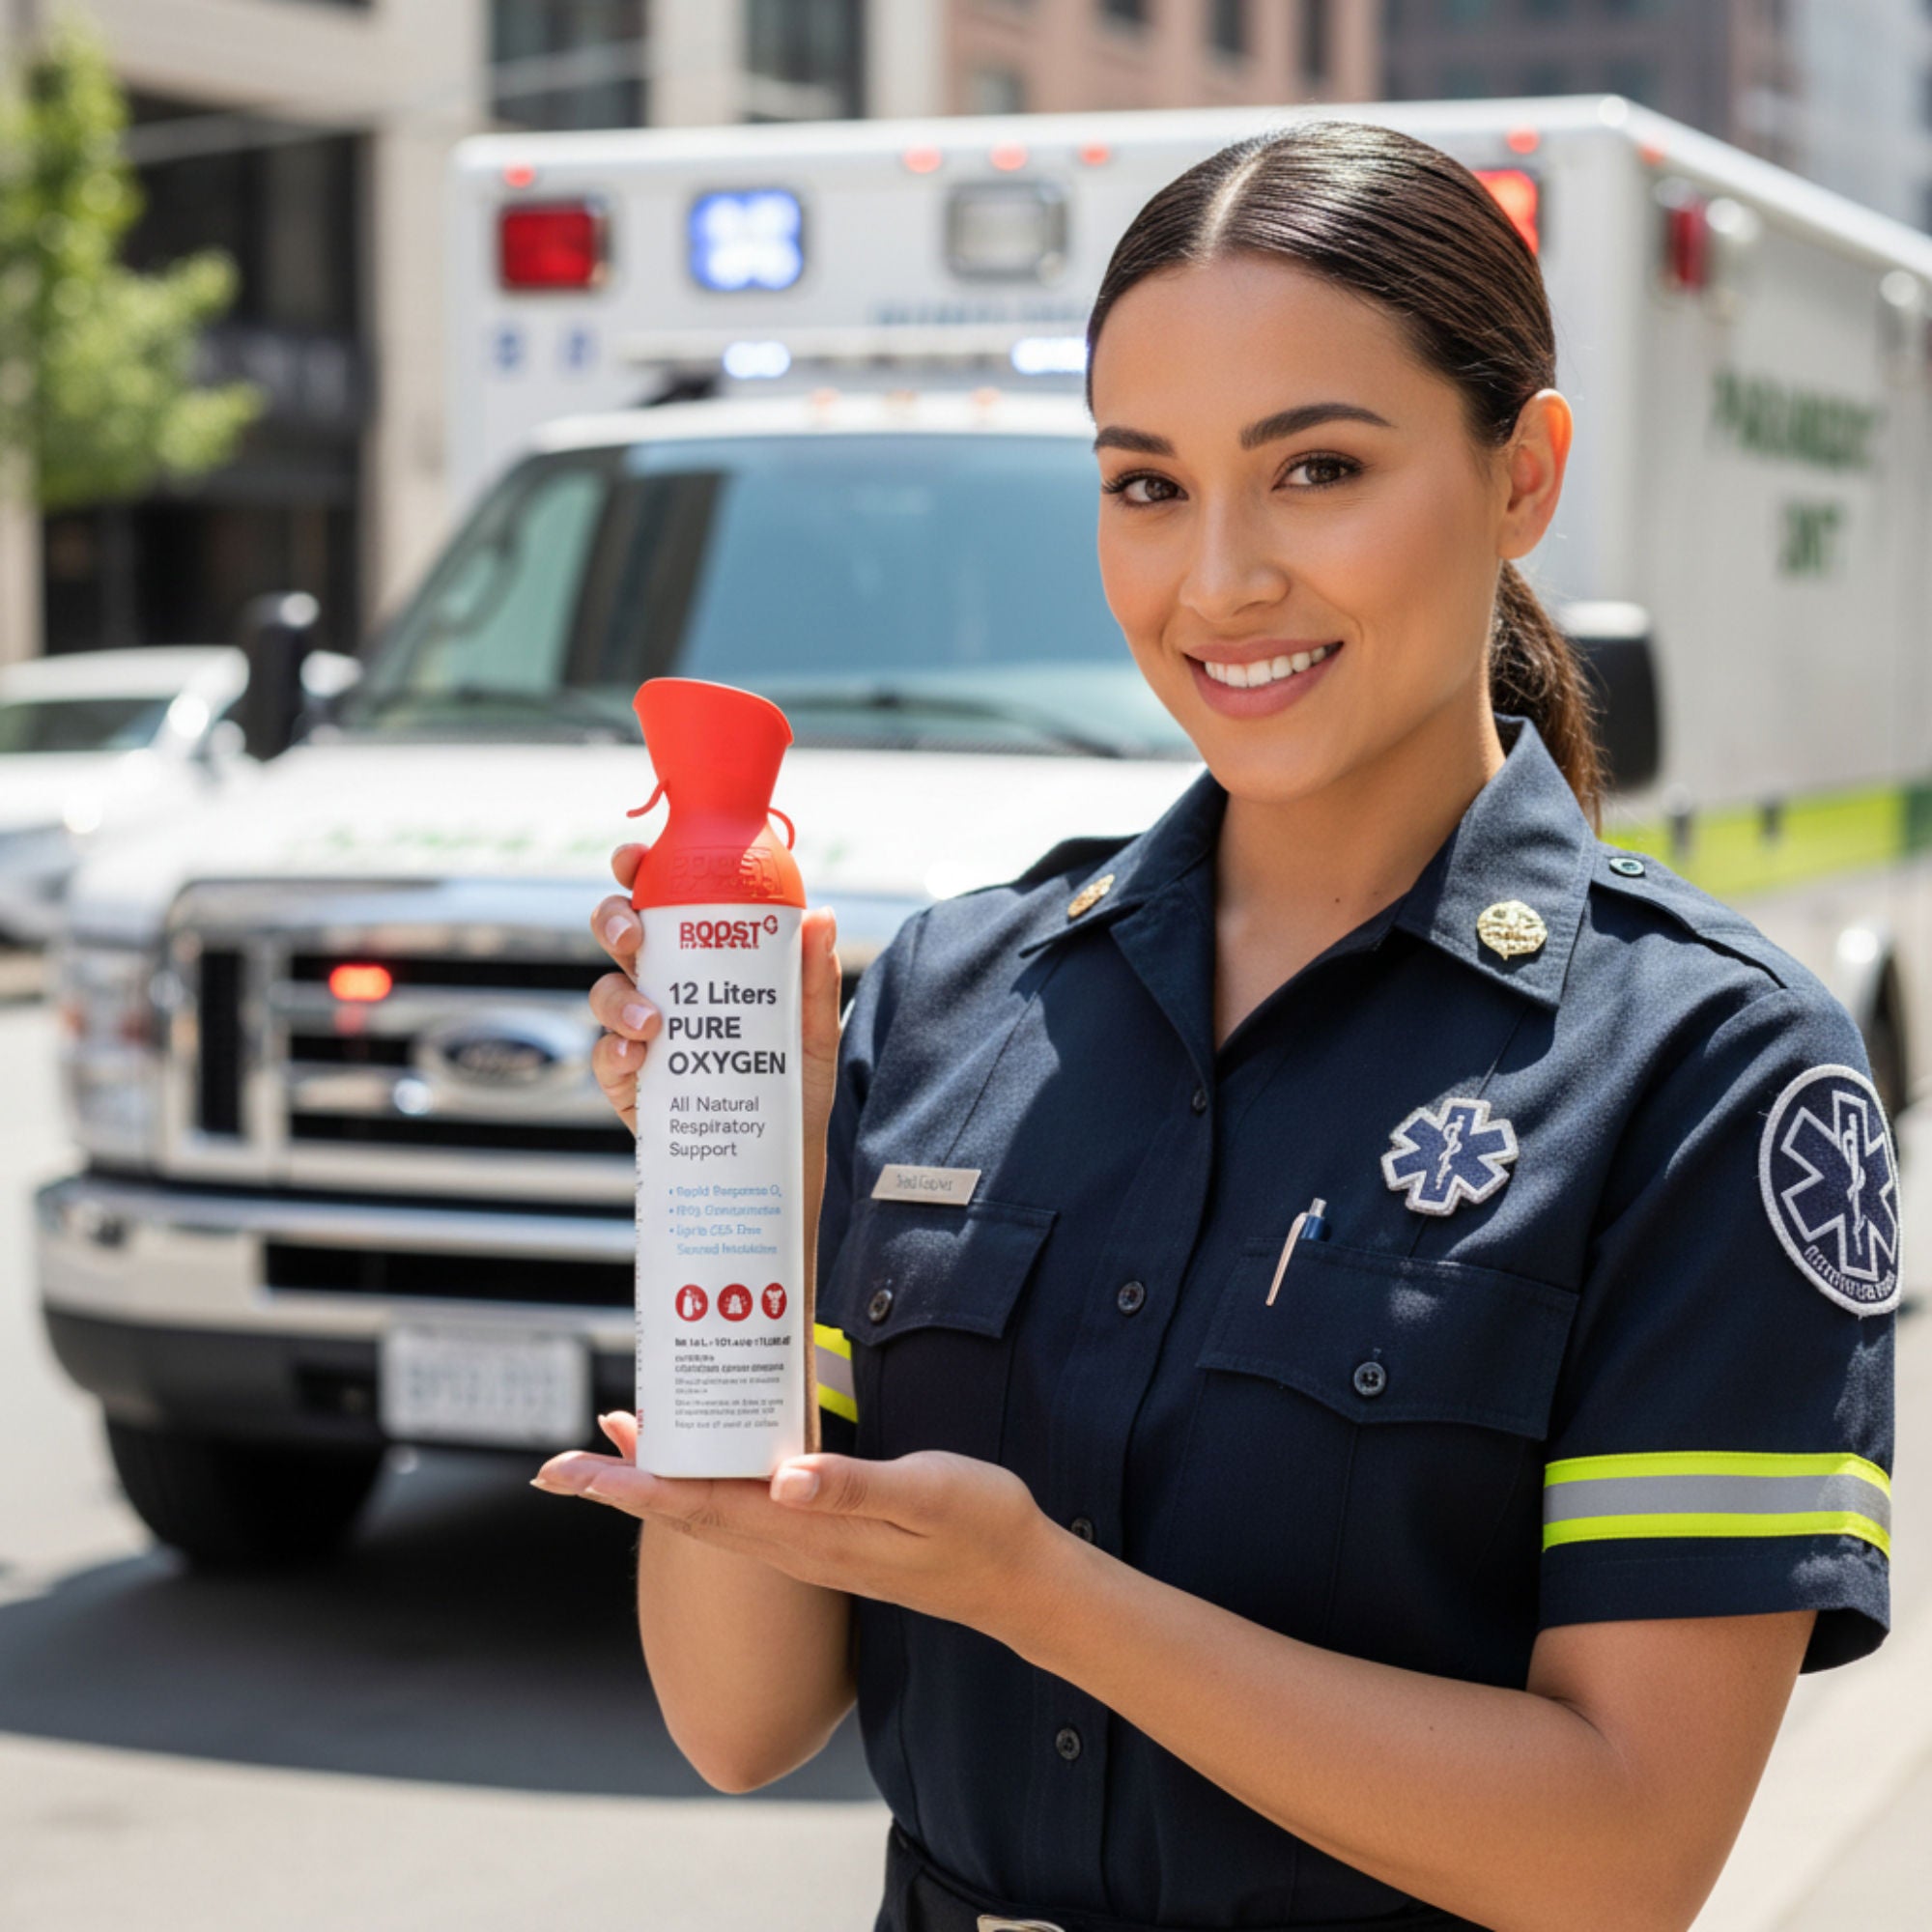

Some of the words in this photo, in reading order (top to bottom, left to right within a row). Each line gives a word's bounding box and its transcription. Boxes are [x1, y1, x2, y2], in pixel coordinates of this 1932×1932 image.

[668, 981, 699, 1005] 12
[708, 980, 777, 1005] Liters
[668, 1016, 742, 1040] PURE
[668, 1050, 786, 1075] OXYGEN
[669, 1095, 690, 1112] All
[696, 1095, 759, 1112] Natural
[669, 1119, 766, 1138] Respiratory
[668, 1141, 738, 1161] Support
